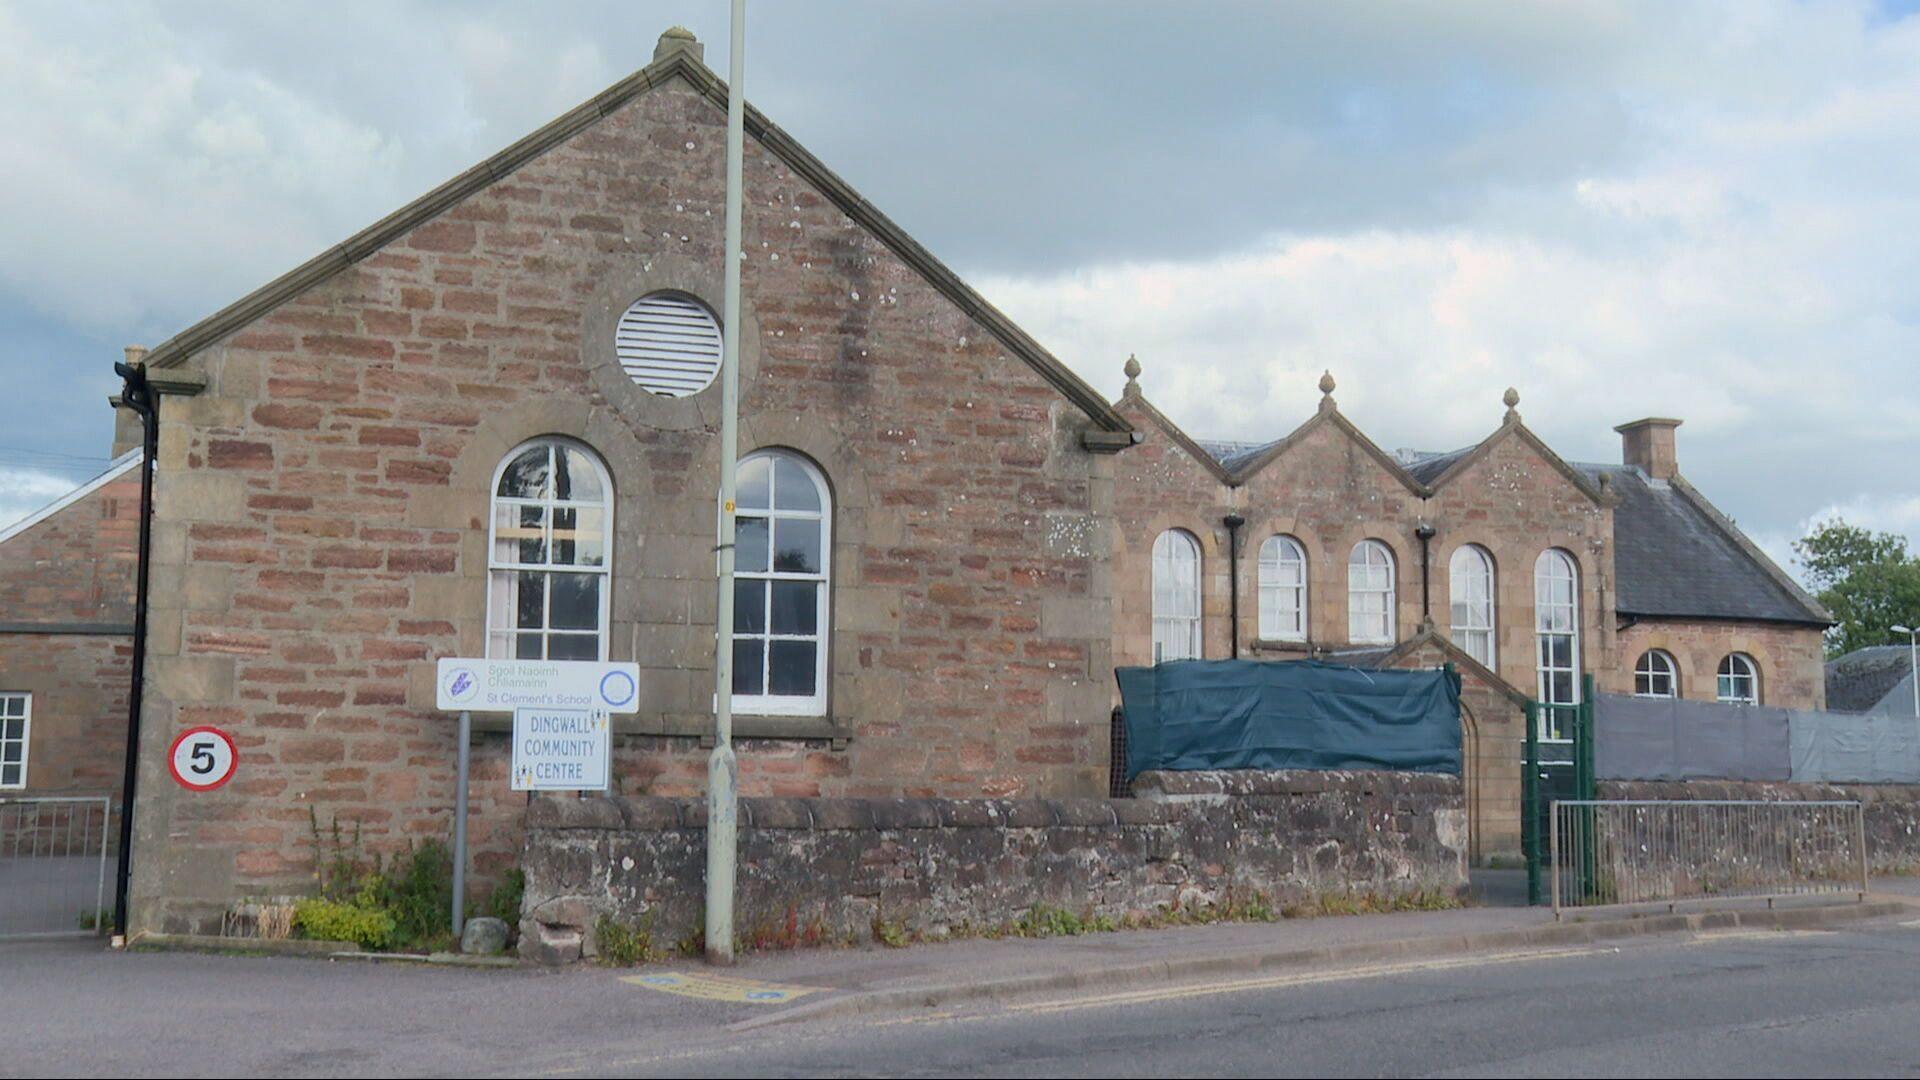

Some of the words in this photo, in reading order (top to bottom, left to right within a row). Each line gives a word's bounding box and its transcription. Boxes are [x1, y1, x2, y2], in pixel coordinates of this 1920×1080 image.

[488, 665, 515, 677] Sgoil
[518, 665, 559, 676] Naoimh
[487, 692, 498, 704] St
[500, 693, 553, 704] Clement's
[556, 694, 592, 705] School
[530, 716, 590, 734] DINGWALL
[524, 739, 595, 756] COMMUNITY
[190, 742, 216, 774] 5
[536, 762, 583, 779] CENTRE
